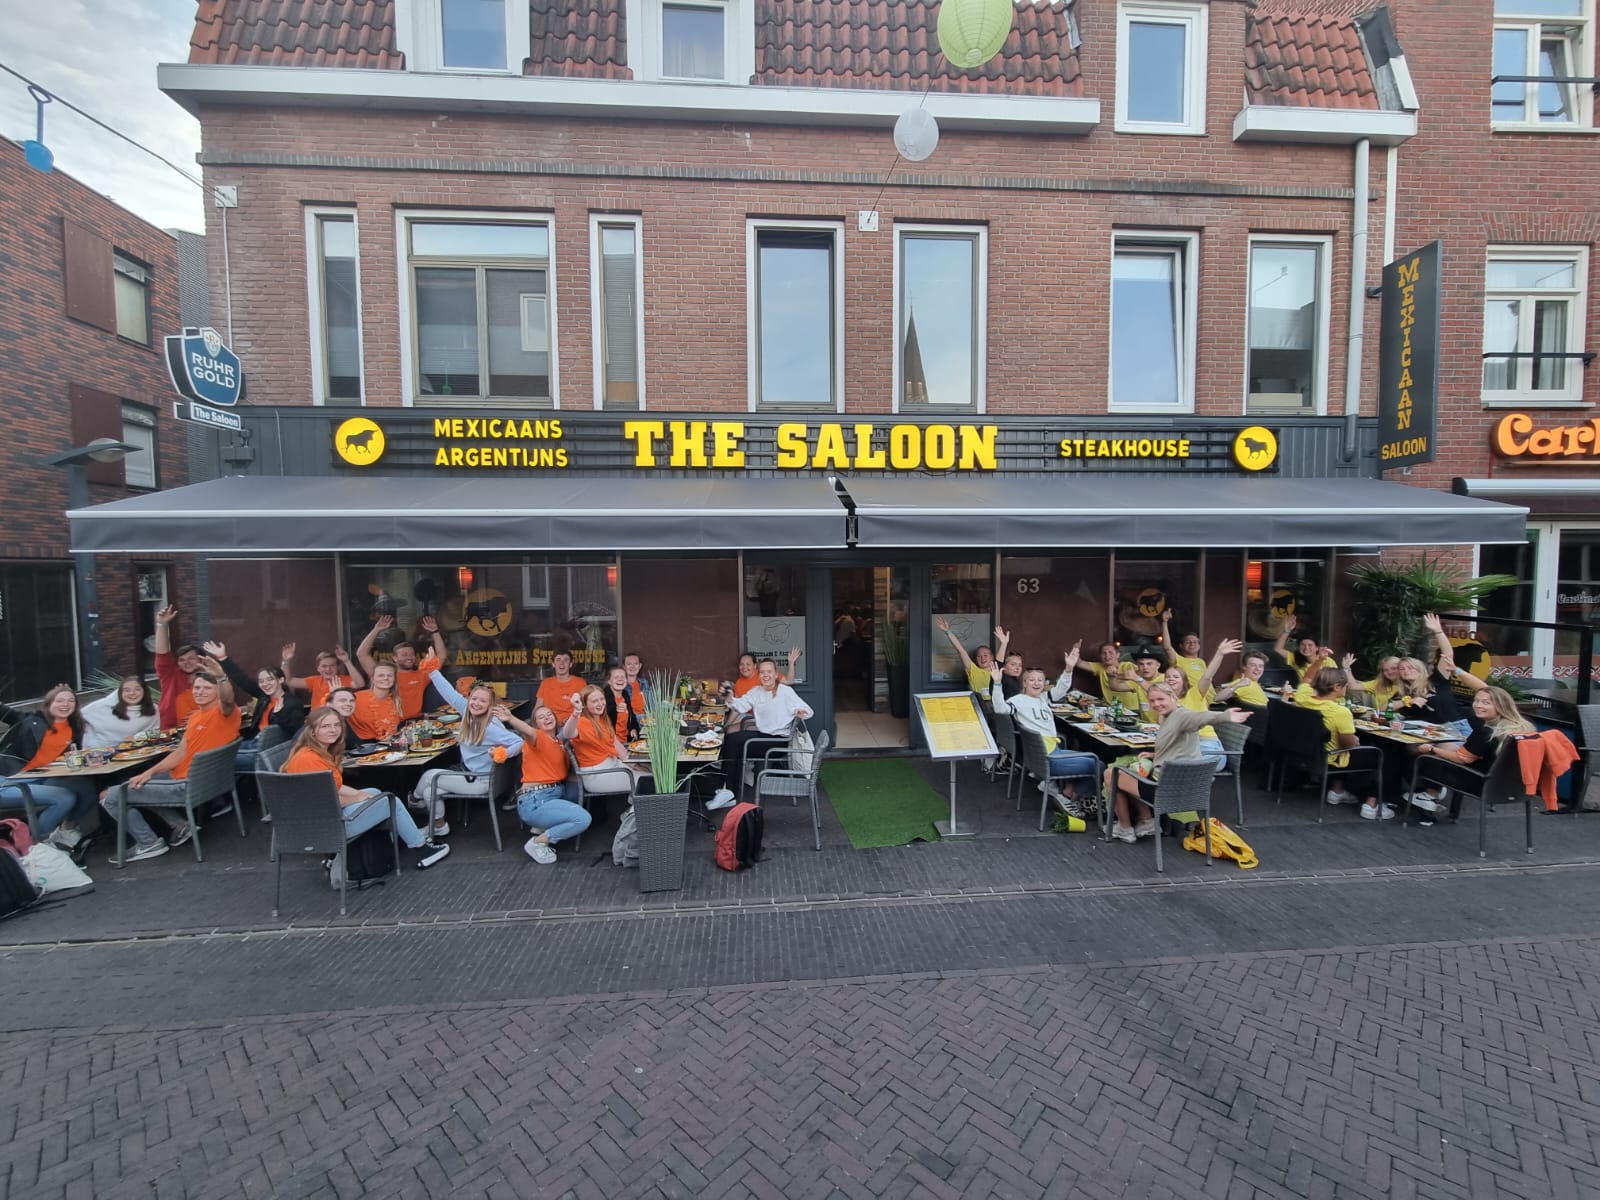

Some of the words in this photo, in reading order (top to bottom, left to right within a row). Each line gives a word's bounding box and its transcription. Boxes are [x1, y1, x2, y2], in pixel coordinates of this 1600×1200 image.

[1397, 257, 1420, 430] MEXICAAN
[192, 353, 235, 377] RUHR
[193, 367, 235, 389] GOLD
[195, 407, 210, 419] The
[212, 412, 238, 426] Saloon
[433, 418, 563, 440] MEXICAANS
[434, 446, 569, 468] ARGENTIJNS
[623, 421, 745, 468] THE
[776, 422, 998, 472] SALOON
[1060, 437, 1192, 459] STEAKHOUSE
[1381, 437, 1427, 460] SALOON
[1017, 578, 1040, 594] 63
